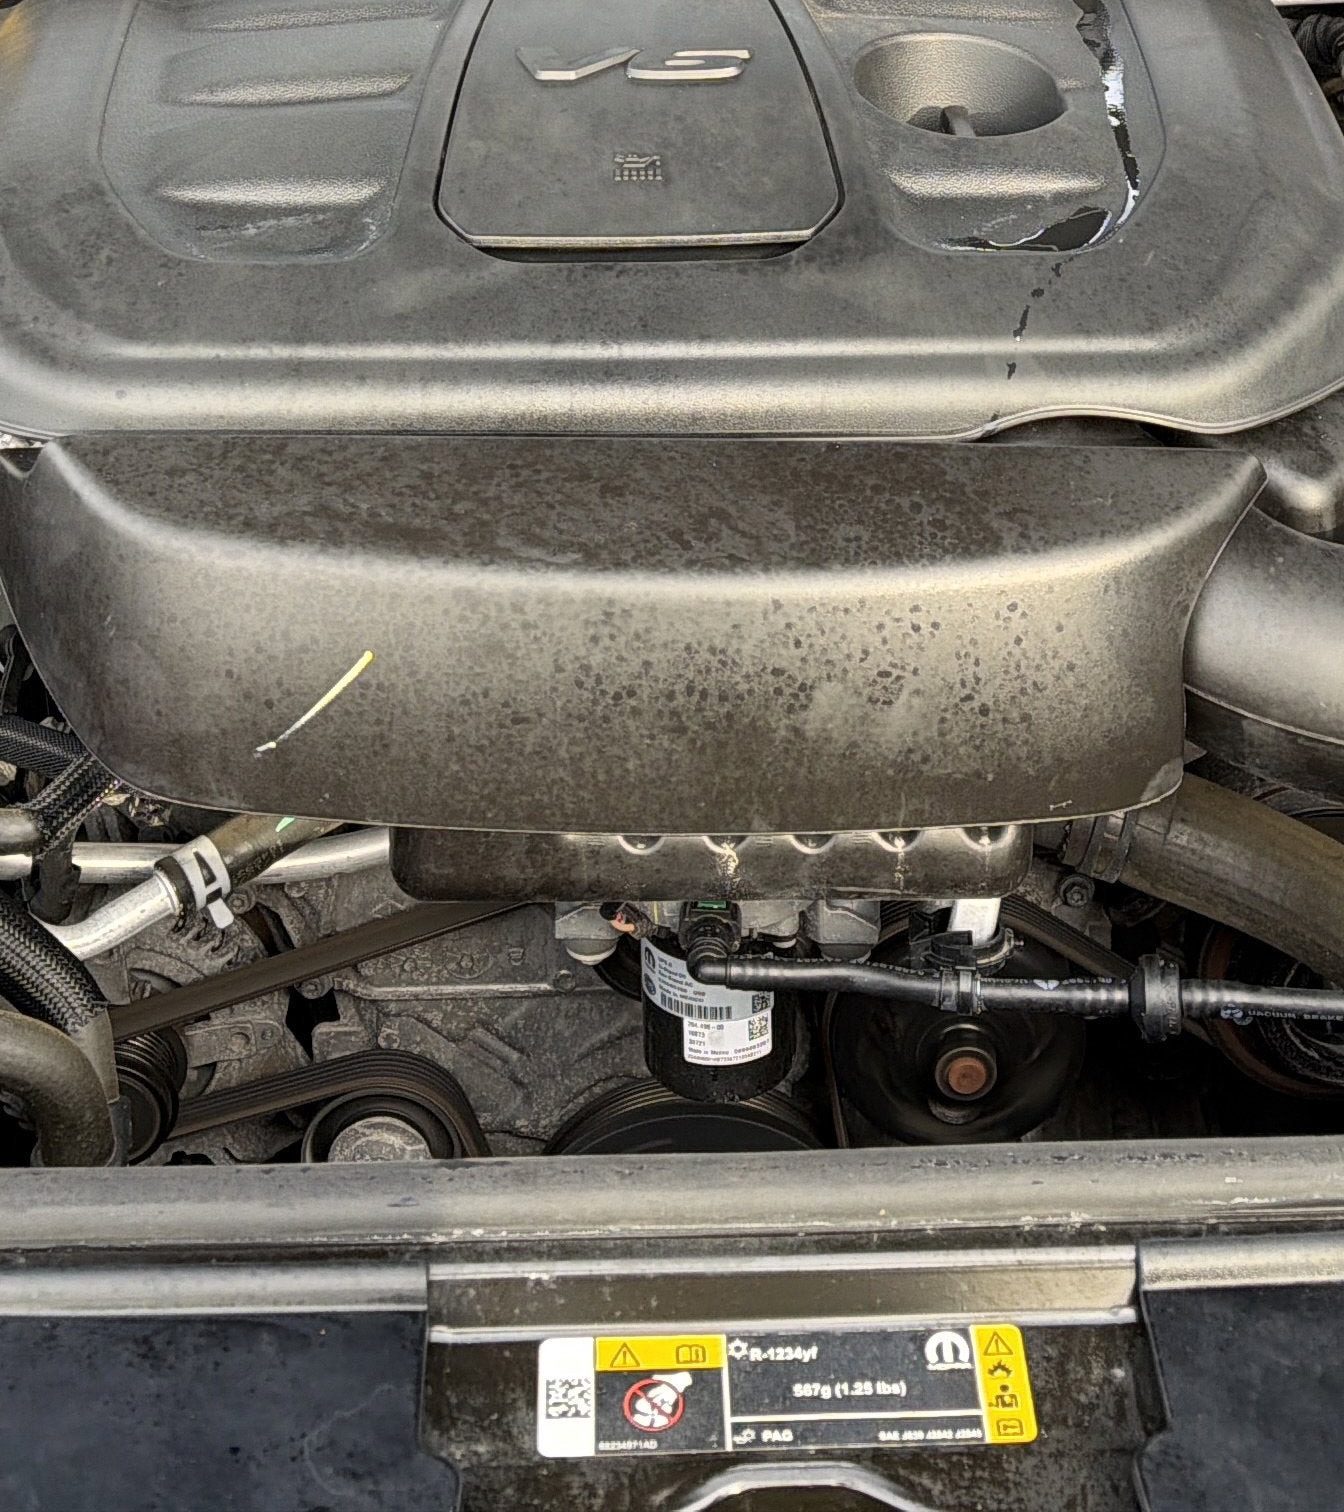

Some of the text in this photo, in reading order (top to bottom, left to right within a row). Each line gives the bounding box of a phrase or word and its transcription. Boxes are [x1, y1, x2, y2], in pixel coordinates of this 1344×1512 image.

[749, 1345, 819, 1363] R-1234yf
[792, 1380, 907, 1400] 567g (1.25 lbs)
[761, 1428, 794, 1442] PAG
